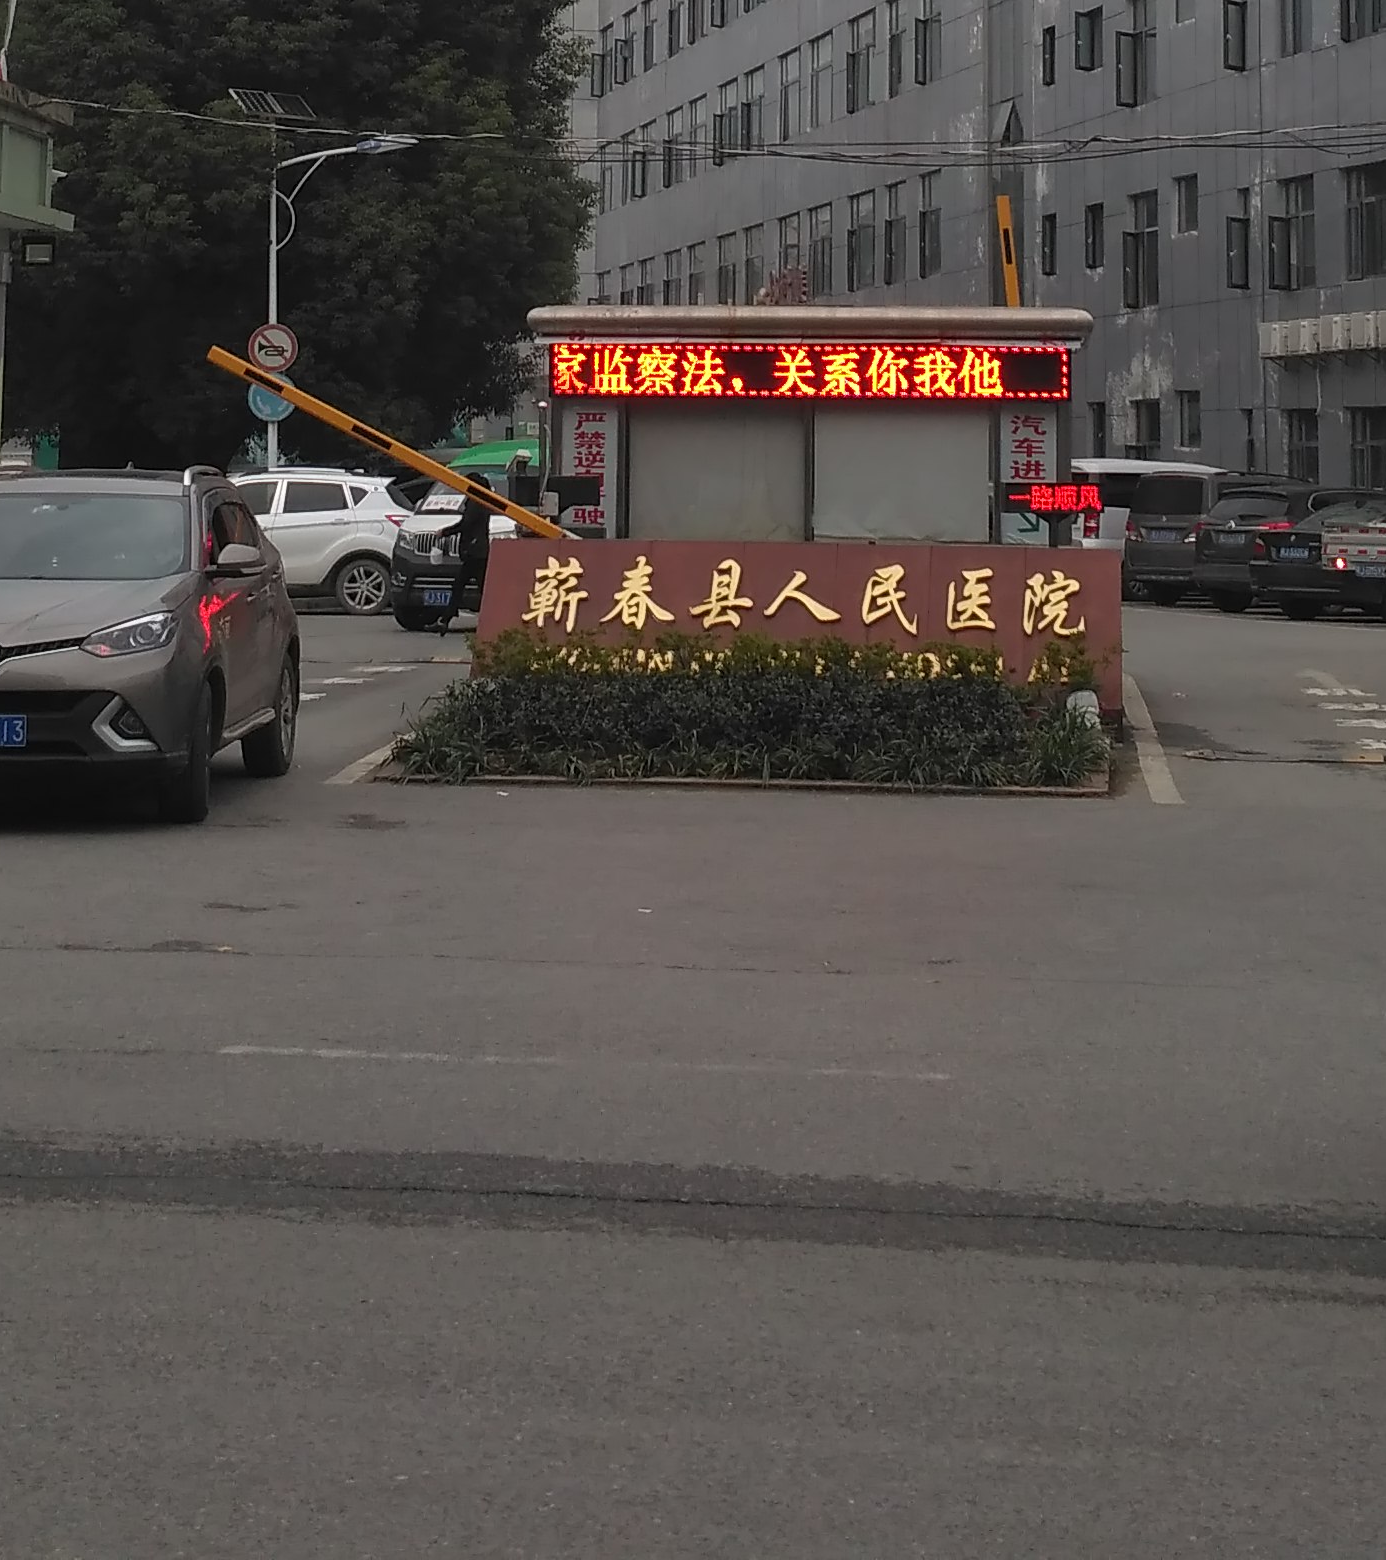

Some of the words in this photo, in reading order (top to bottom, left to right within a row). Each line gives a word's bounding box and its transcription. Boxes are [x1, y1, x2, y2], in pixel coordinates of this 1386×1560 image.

[573, 412, 607, 527] 严禁逆驶
[1010, 414, 1047, 481] 汽车进
[1008, 485, 1102, 511] 一路顺风
[521, 554, 1088, 638] 蕲春县人民医院
